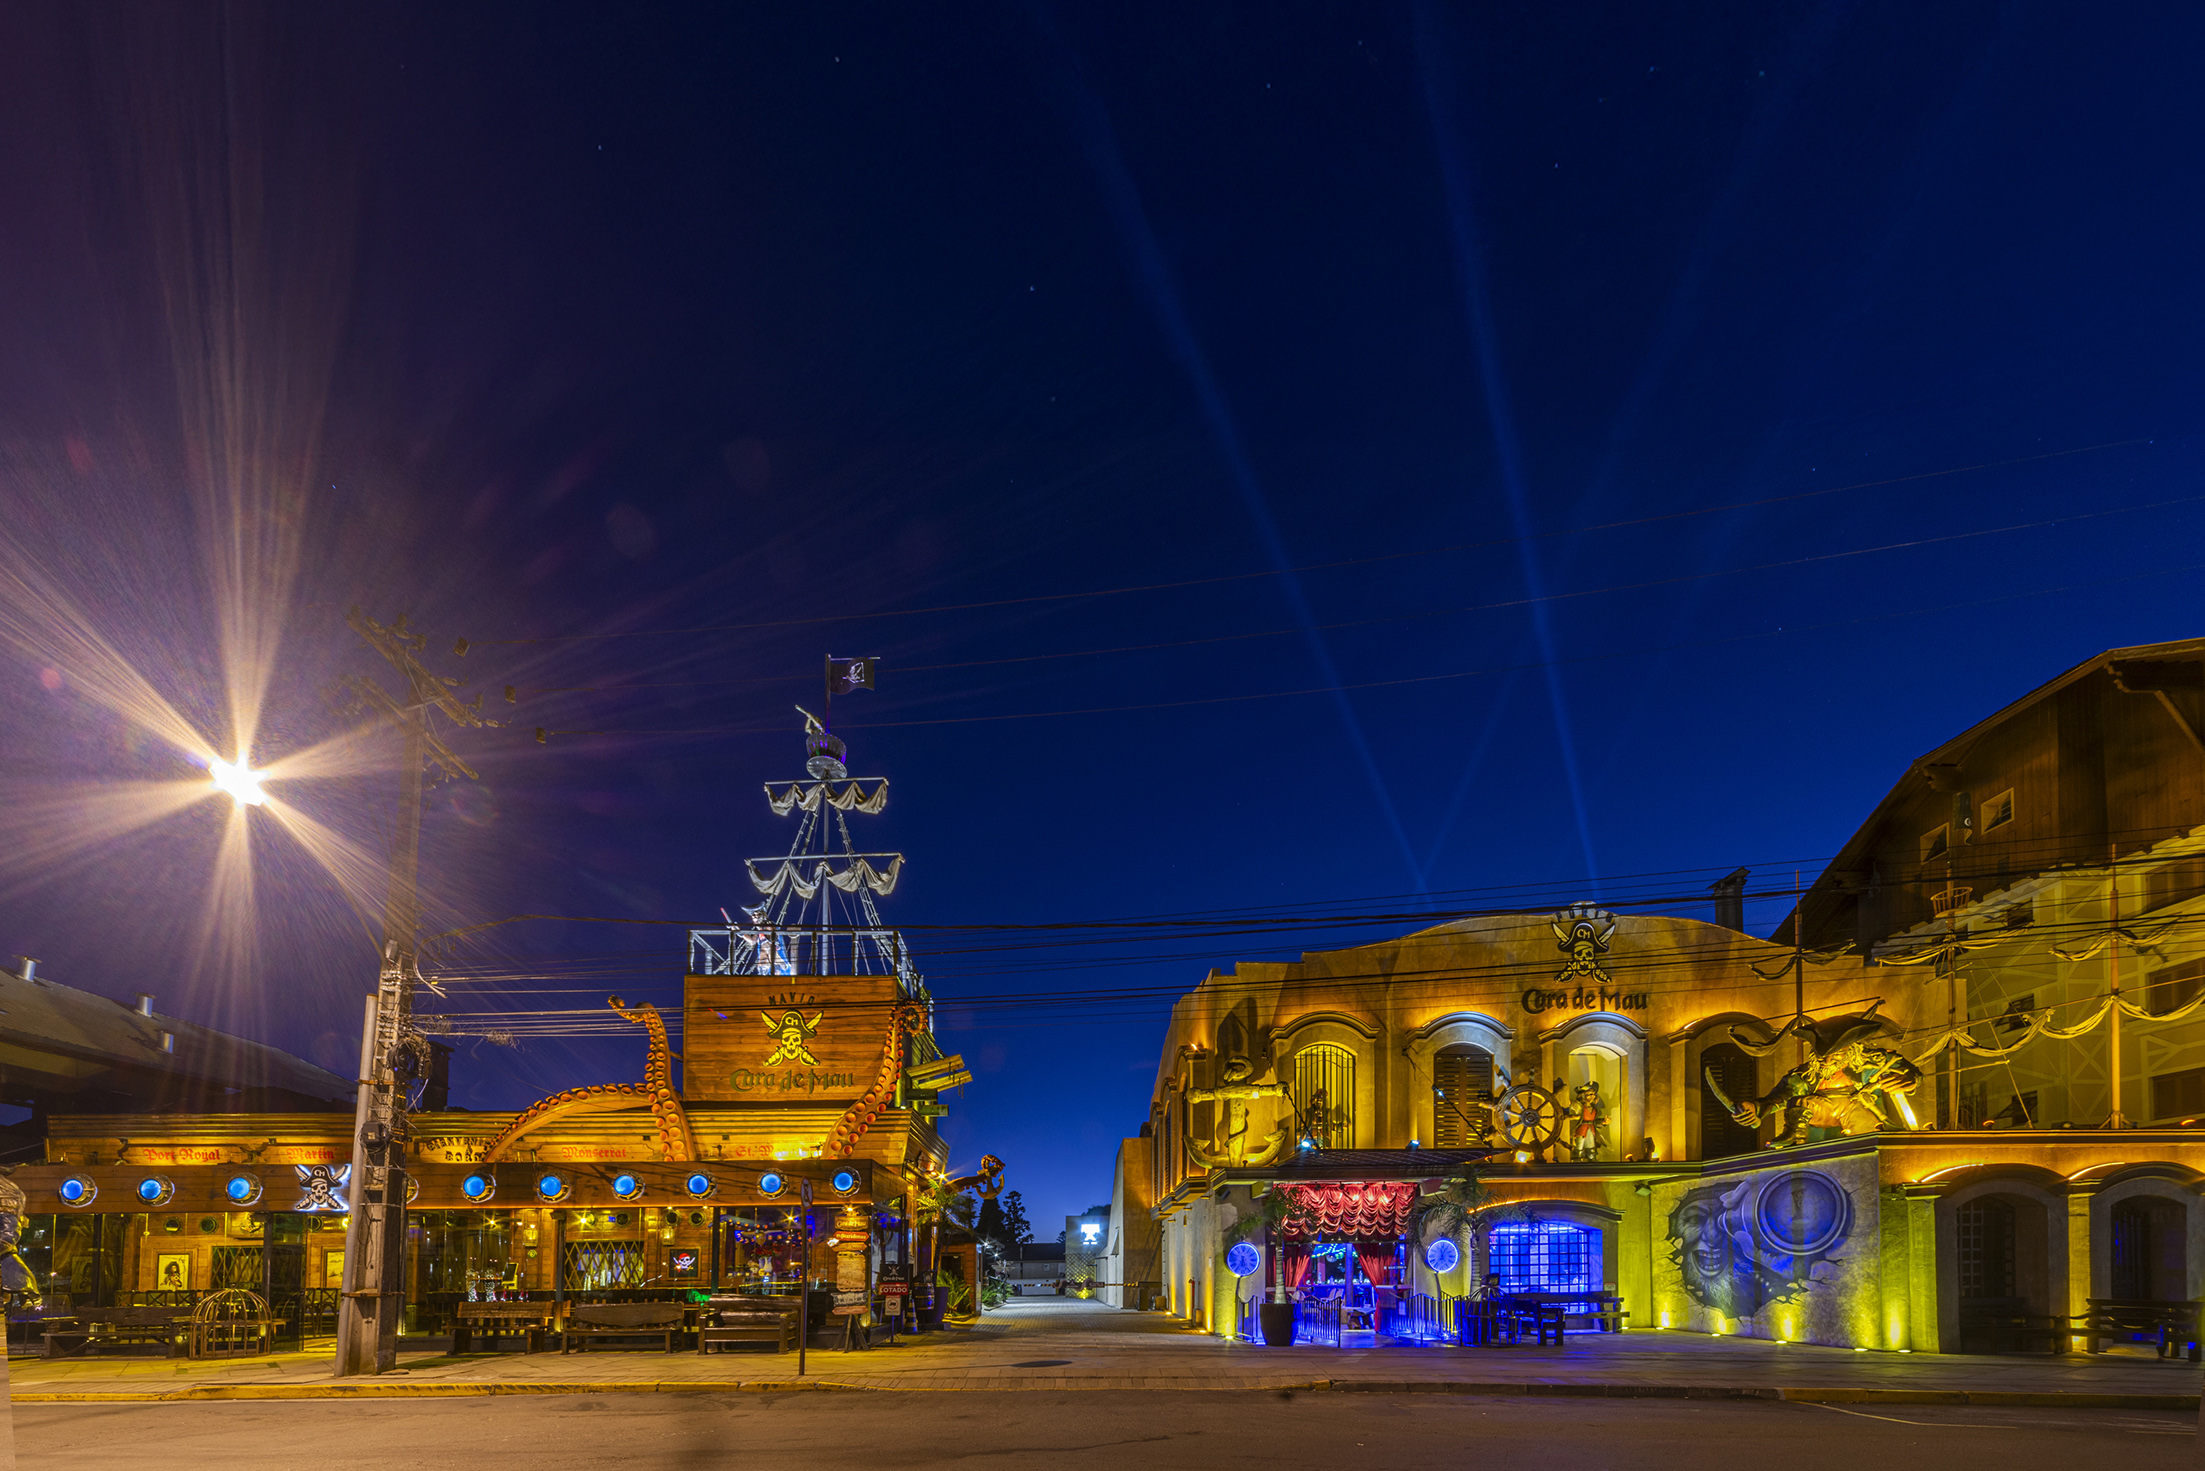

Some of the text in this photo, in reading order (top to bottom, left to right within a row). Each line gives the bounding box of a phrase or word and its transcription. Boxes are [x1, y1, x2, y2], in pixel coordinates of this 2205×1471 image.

[1577, 928, 1591, 939] CM
[768, 991, 815, 1006] NAVIO
[1521, 986, 1648, 1014] Cara de Mau
[785, 1017, 798, 1026] CM
[729, 1068, 854, 1095] Cara de Mau
[143, 1147, 221, 1163] Port Royal
[562, 1146, 627, 1159] Monserrat
[735, 1145, 755, 1157] St.
[313, 1168, 326, 1178] CM
